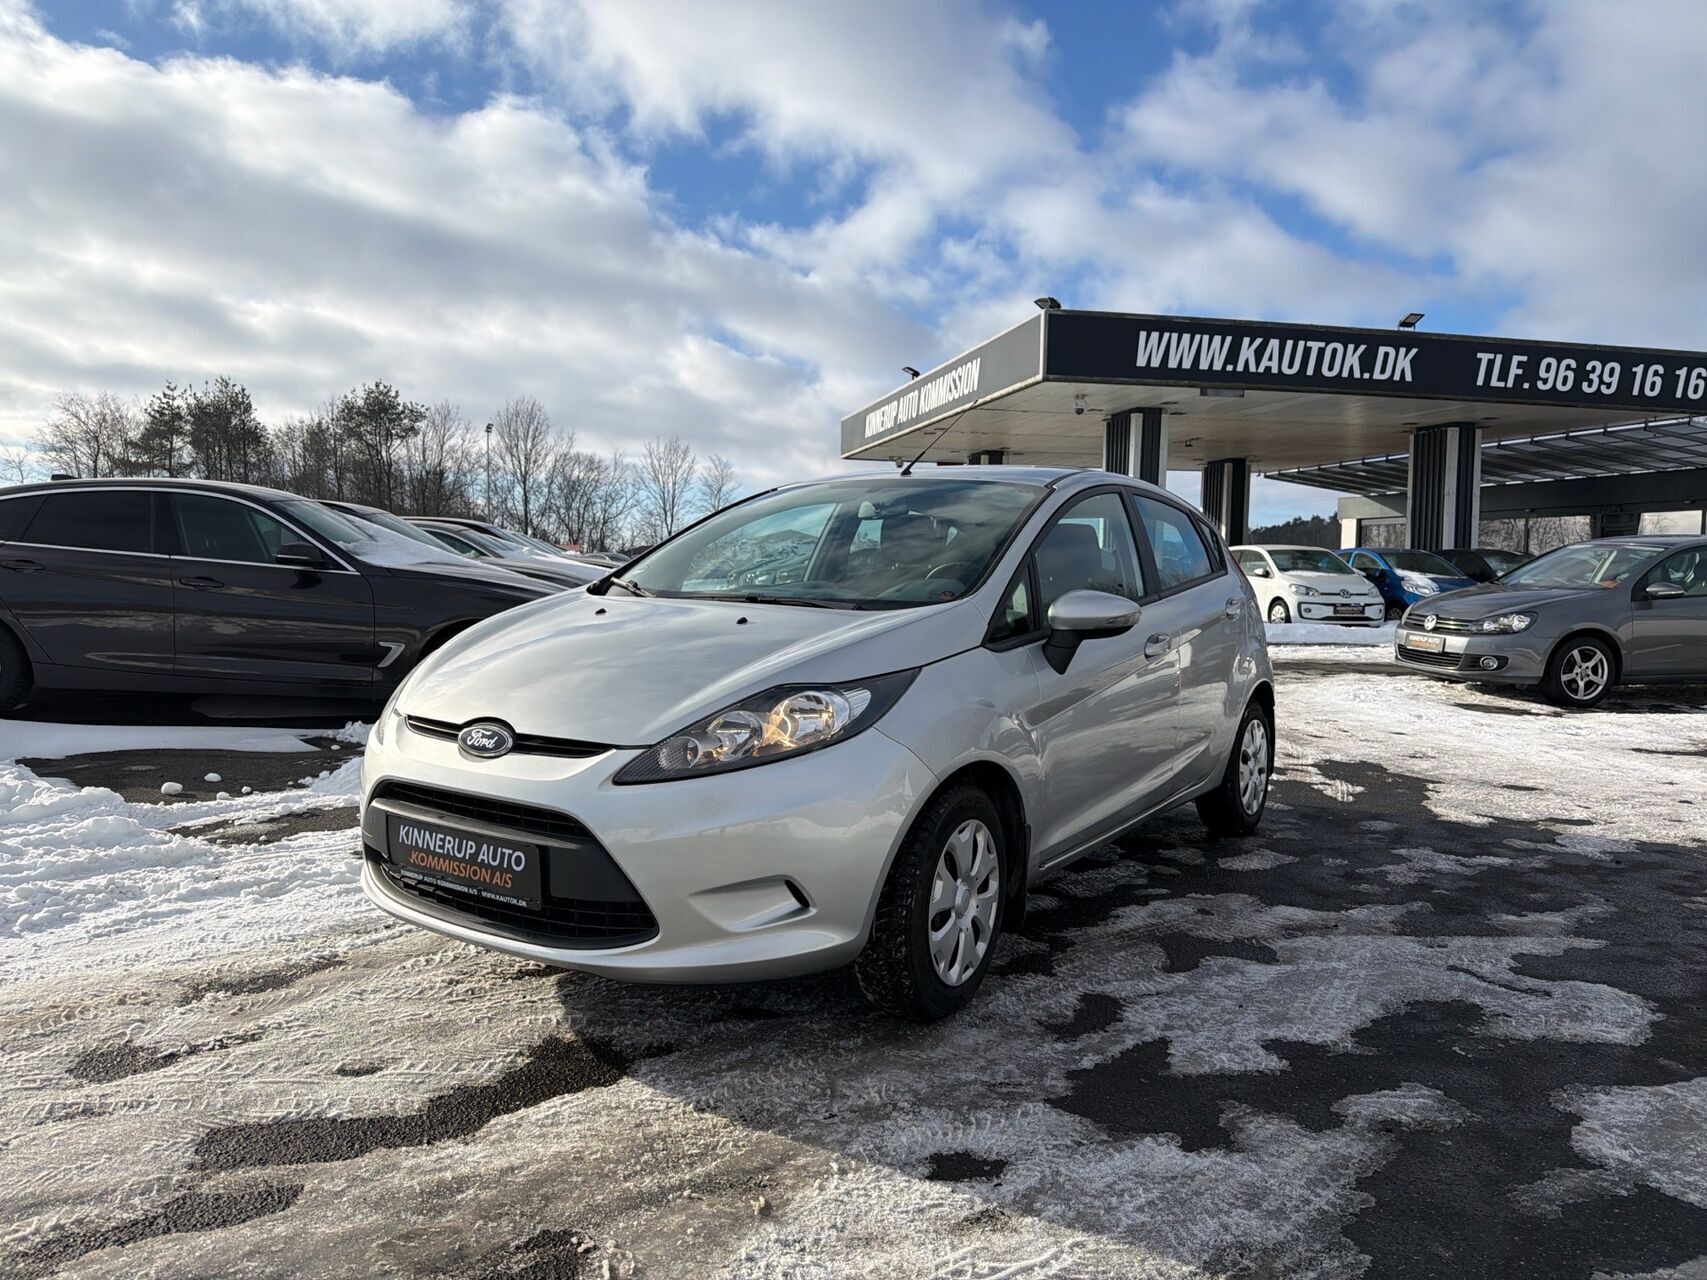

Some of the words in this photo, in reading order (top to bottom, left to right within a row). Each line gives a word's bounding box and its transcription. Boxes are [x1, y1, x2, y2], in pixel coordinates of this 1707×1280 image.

[1135, 331, 1418, 382] WWW.KAUTOK.DK
[1476, 352, 1530, 389] TLF.
[1536, 357, 1577, 392] 96
[1581, 360, 1621, 395] 39
[1631, 364, 1664, 397] 16
[1674, 366, 1707, 400] 16
[865, 400, 898, 438] KINNERUP
[898, 389, 919, 424] AUTO
[919, 357, 981, 415] KOMMISSION
[467, 729, 498, 749] Ford
[399, 824, 476, 860] KINNERUP
[478, 843, 526, 872] AUTO
[408, 850, 491, 884] KOMMISSION
[492, 871, 513, 888] A/S
